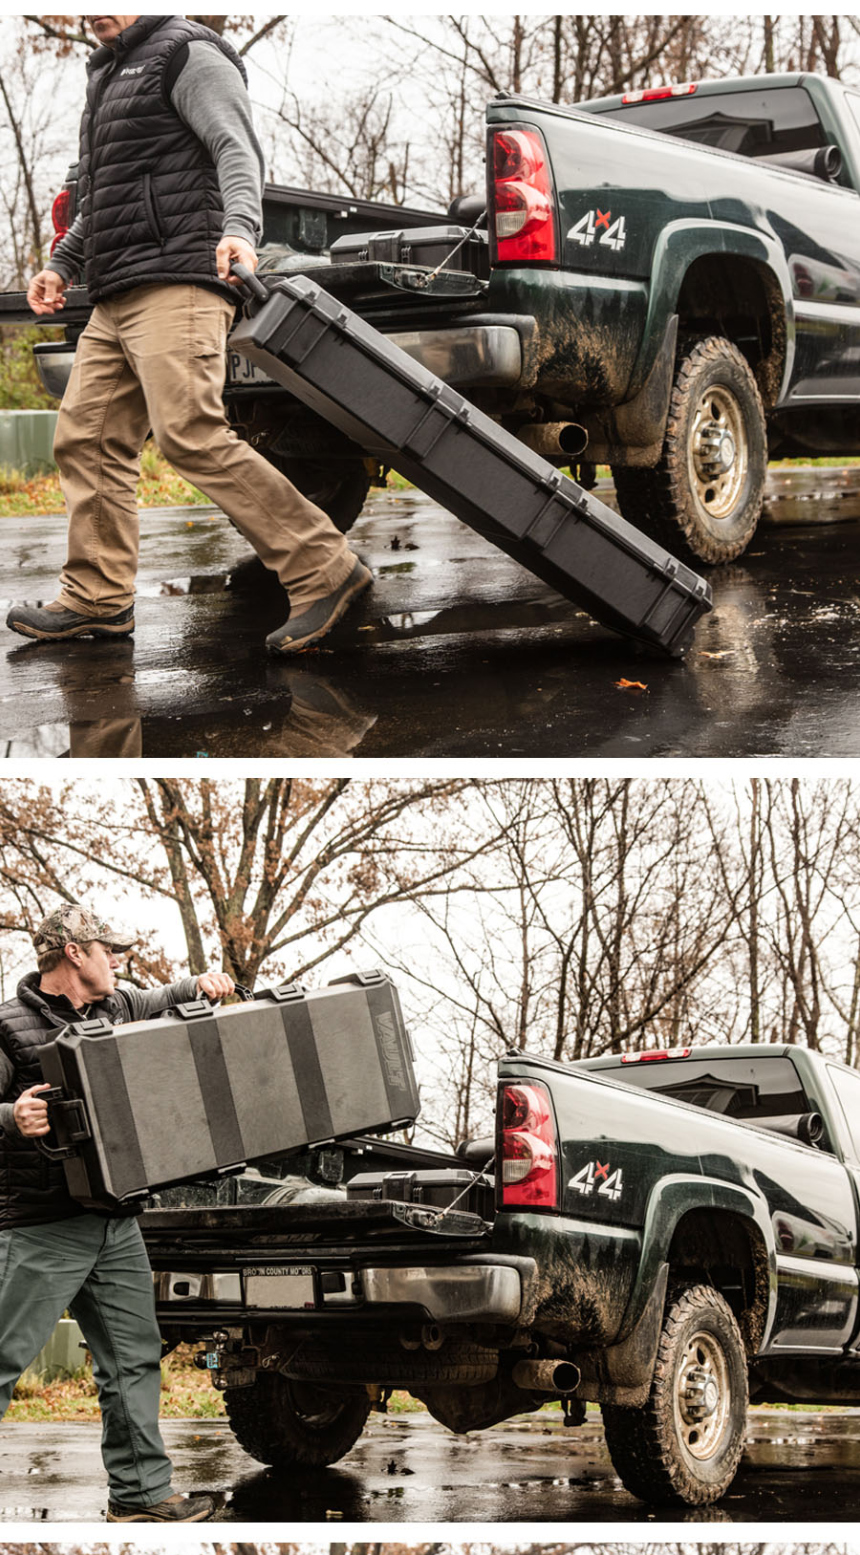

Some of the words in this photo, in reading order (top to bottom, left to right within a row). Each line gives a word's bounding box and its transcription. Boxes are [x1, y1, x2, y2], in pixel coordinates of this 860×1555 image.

[375, 1011, 407, 1091] VAULT
[265, 1267, 289, 1276] COUNTY
[290, 1267, 312, 1275] MOORS
